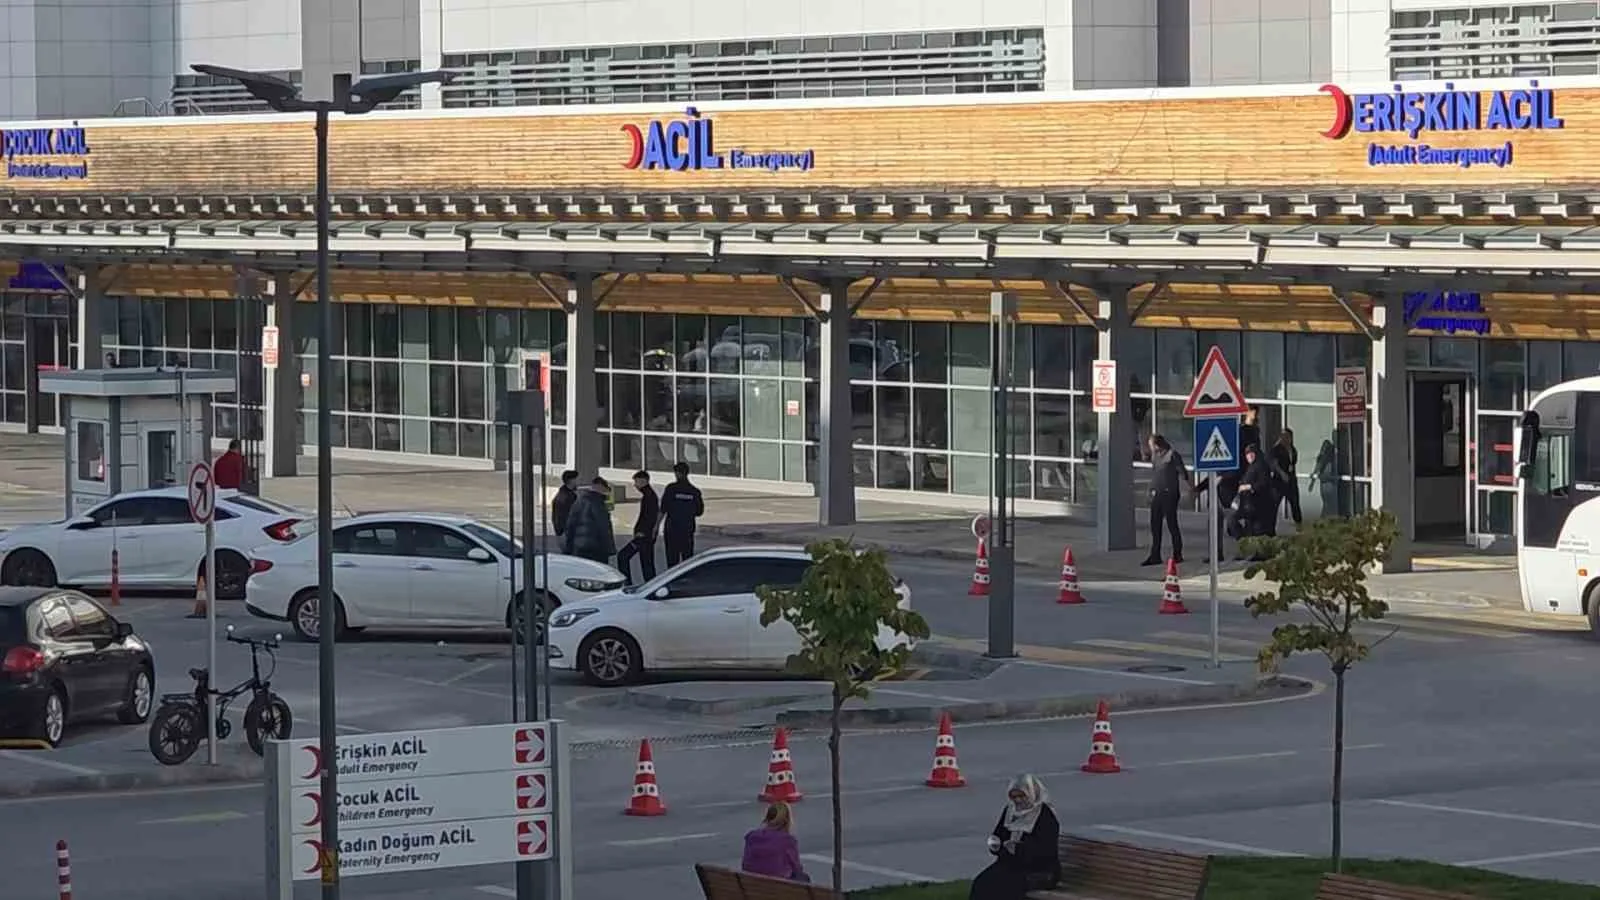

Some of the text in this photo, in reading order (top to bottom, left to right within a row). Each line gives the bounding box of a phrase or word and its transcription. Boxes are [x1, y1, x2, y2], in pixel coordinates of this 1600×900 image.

[1354, 80, 1564, 138] ERİŞKİN ACİL
[56, 121, 90, 155] ACİL
[642, 106, 724, 171] ACİL
[391, 736, 428, 756] ACİL
[362, 761, 418, 773] Emergency
[384, 784, 420, 804] ACİL
[337, 806, 434, 822] hildren Emergency
[381, 833, 435, 852] Doğum
[440, 825, 476, 845] ACİL
[384, 852, 441, 865] Emergency
